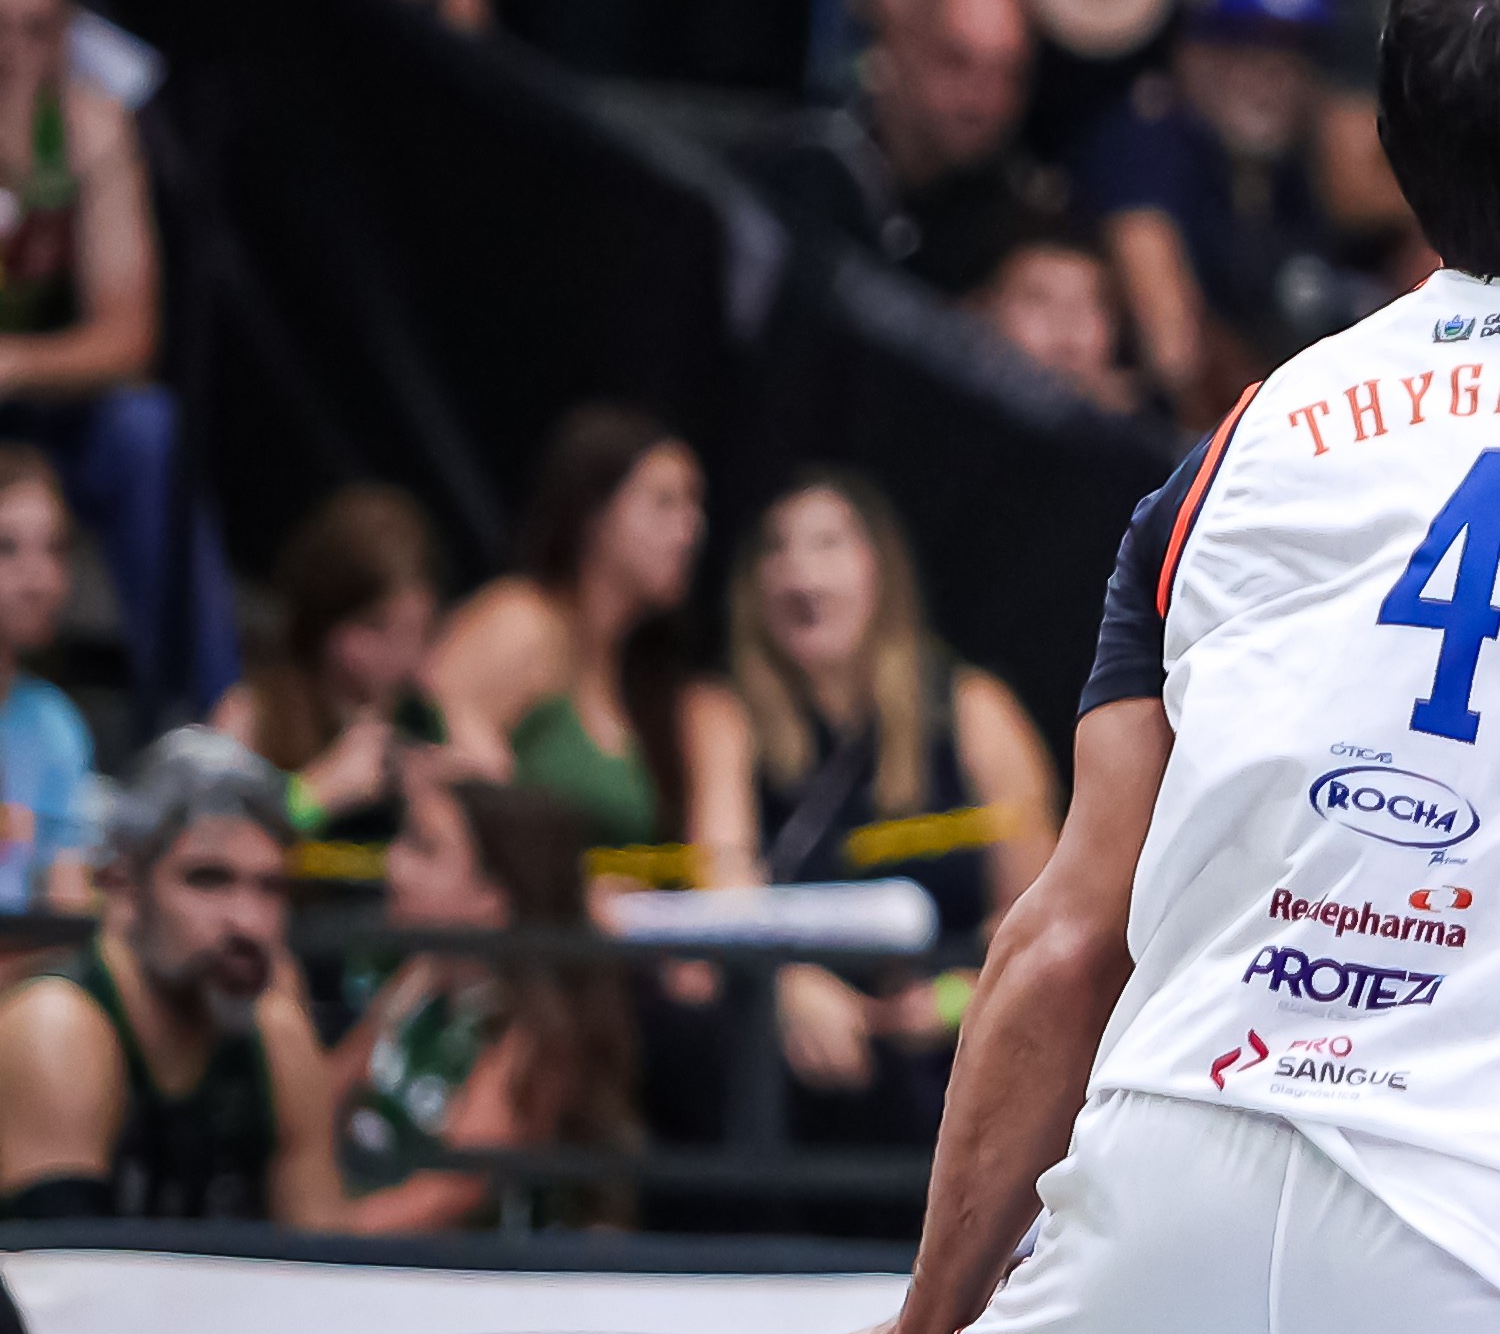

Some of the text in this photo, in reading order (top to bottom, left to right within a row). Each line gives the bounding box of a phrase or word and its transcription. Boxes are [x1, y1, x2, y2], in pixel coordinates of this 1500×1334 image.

[1326, 779, 1459, 834] ROCHA
[1268, 887, 1468, 948] Redepharma
[1286, 1034, 1353, 1058] PRO
[1273, 1055, 1412, 1091] SANGUE
